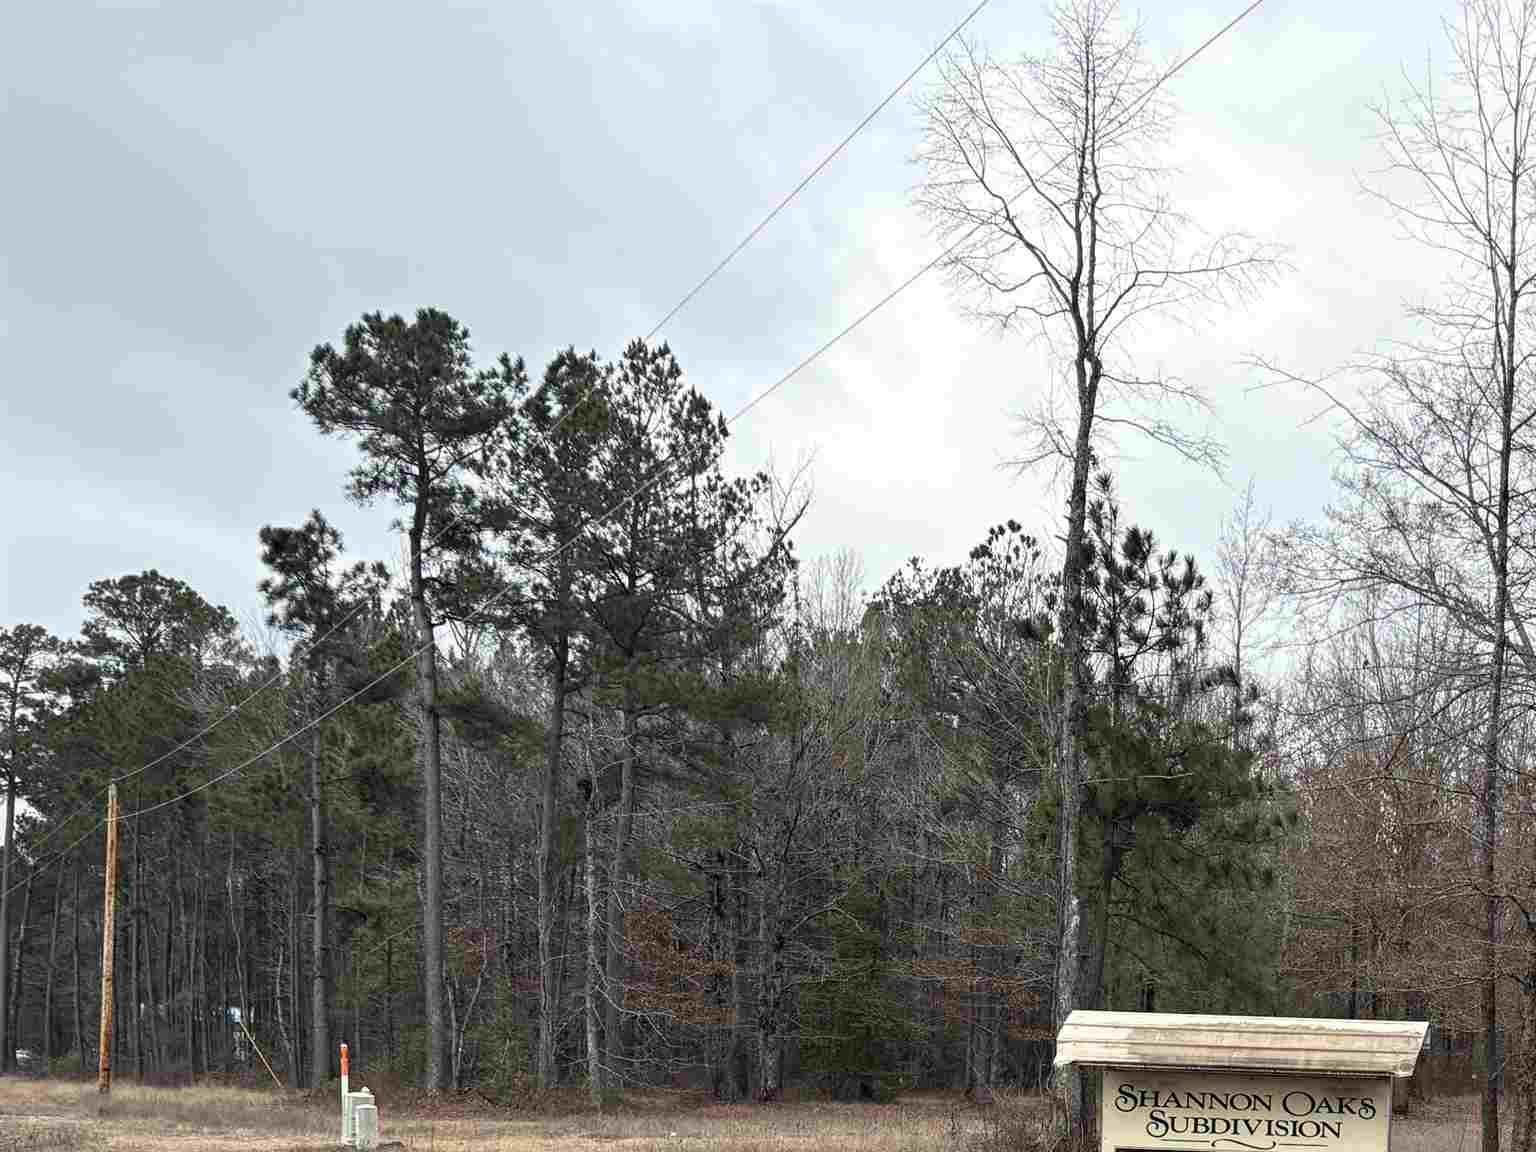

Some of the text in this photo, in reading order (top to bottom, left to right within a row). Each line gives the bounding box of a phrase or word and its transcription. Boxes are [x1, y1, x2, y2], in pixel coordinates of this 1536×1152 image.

[1115, 1083, 1376, 1120] SHANNON OAKS
[1146, 1109, 1343, 1138] SUBDIVISION
